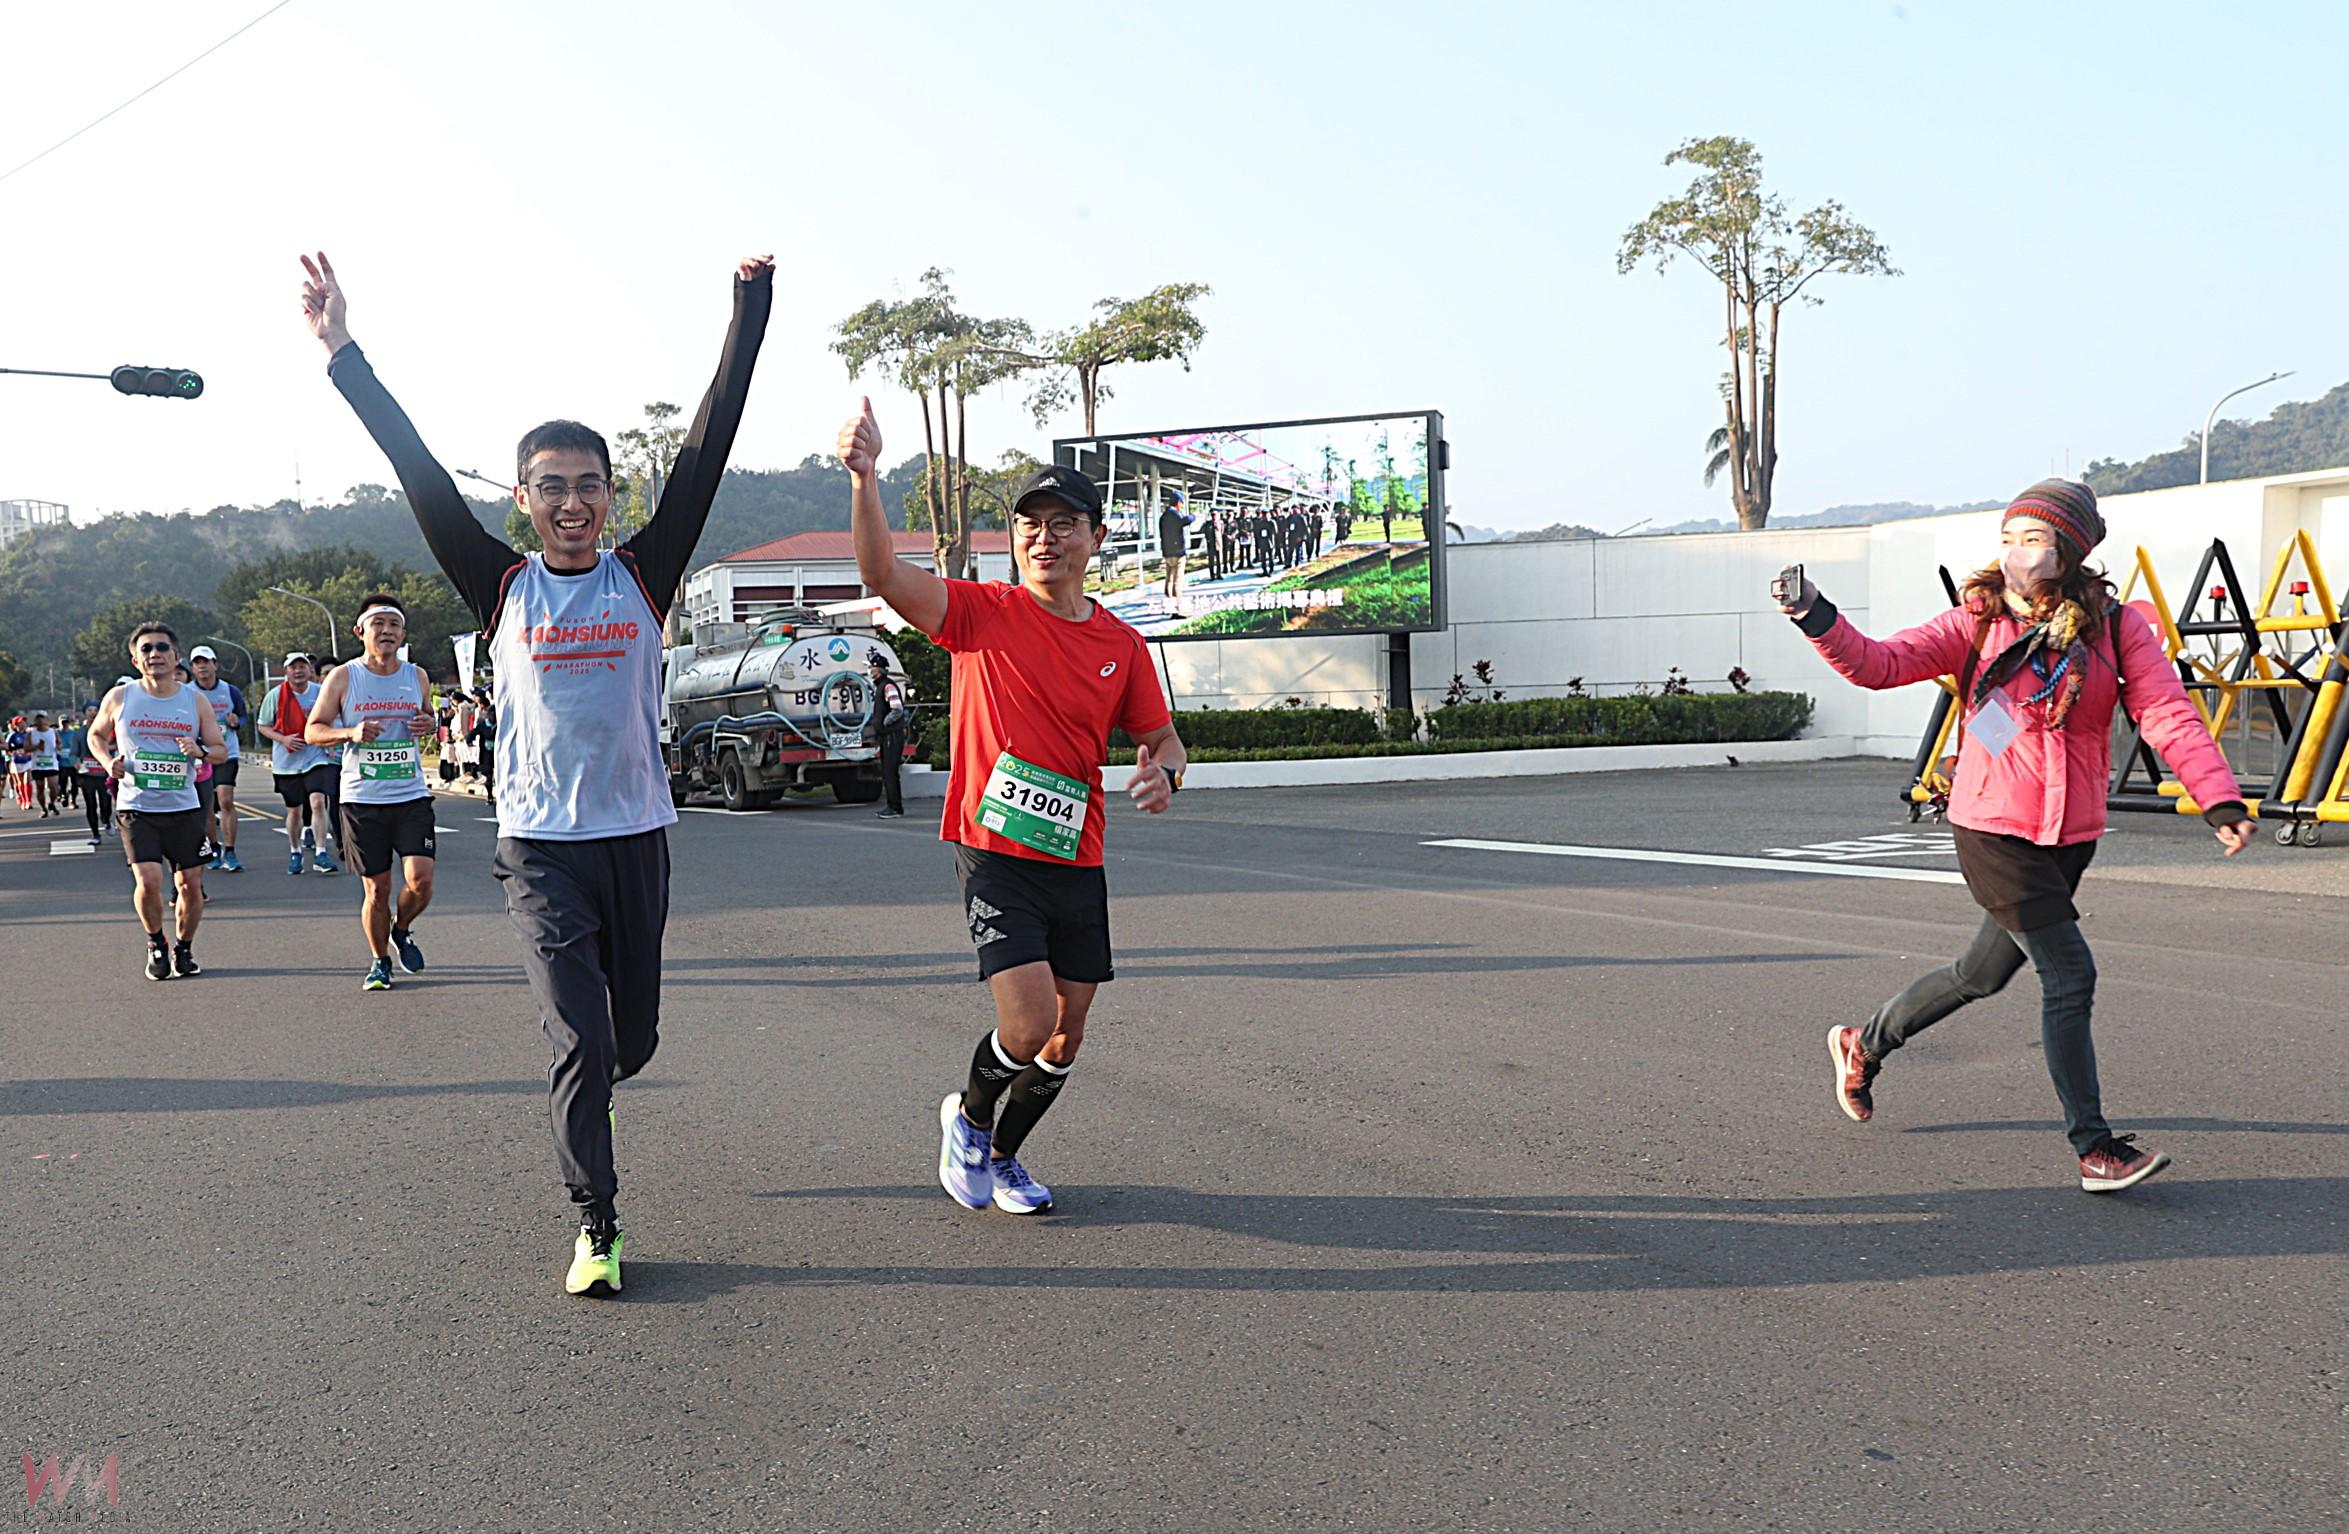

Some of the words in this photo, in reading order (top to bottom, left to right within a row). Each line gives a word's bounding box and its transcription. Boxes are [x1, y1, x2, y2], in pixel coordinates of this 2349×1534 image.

[517, 622, 640, 644] KAOHSIUNG
[556, 661, 604, 670] MARATHON
[800, 647, 822, 671] 水
[354, 701, 417, 713] KAOHSIUNG
[129, 719, 192, 733] KAOHSIUNG
[367, 750, 408, 763] 31250
[141, 762, 181, 774] 33526
[1000, 780, 1074, 822] 31904
